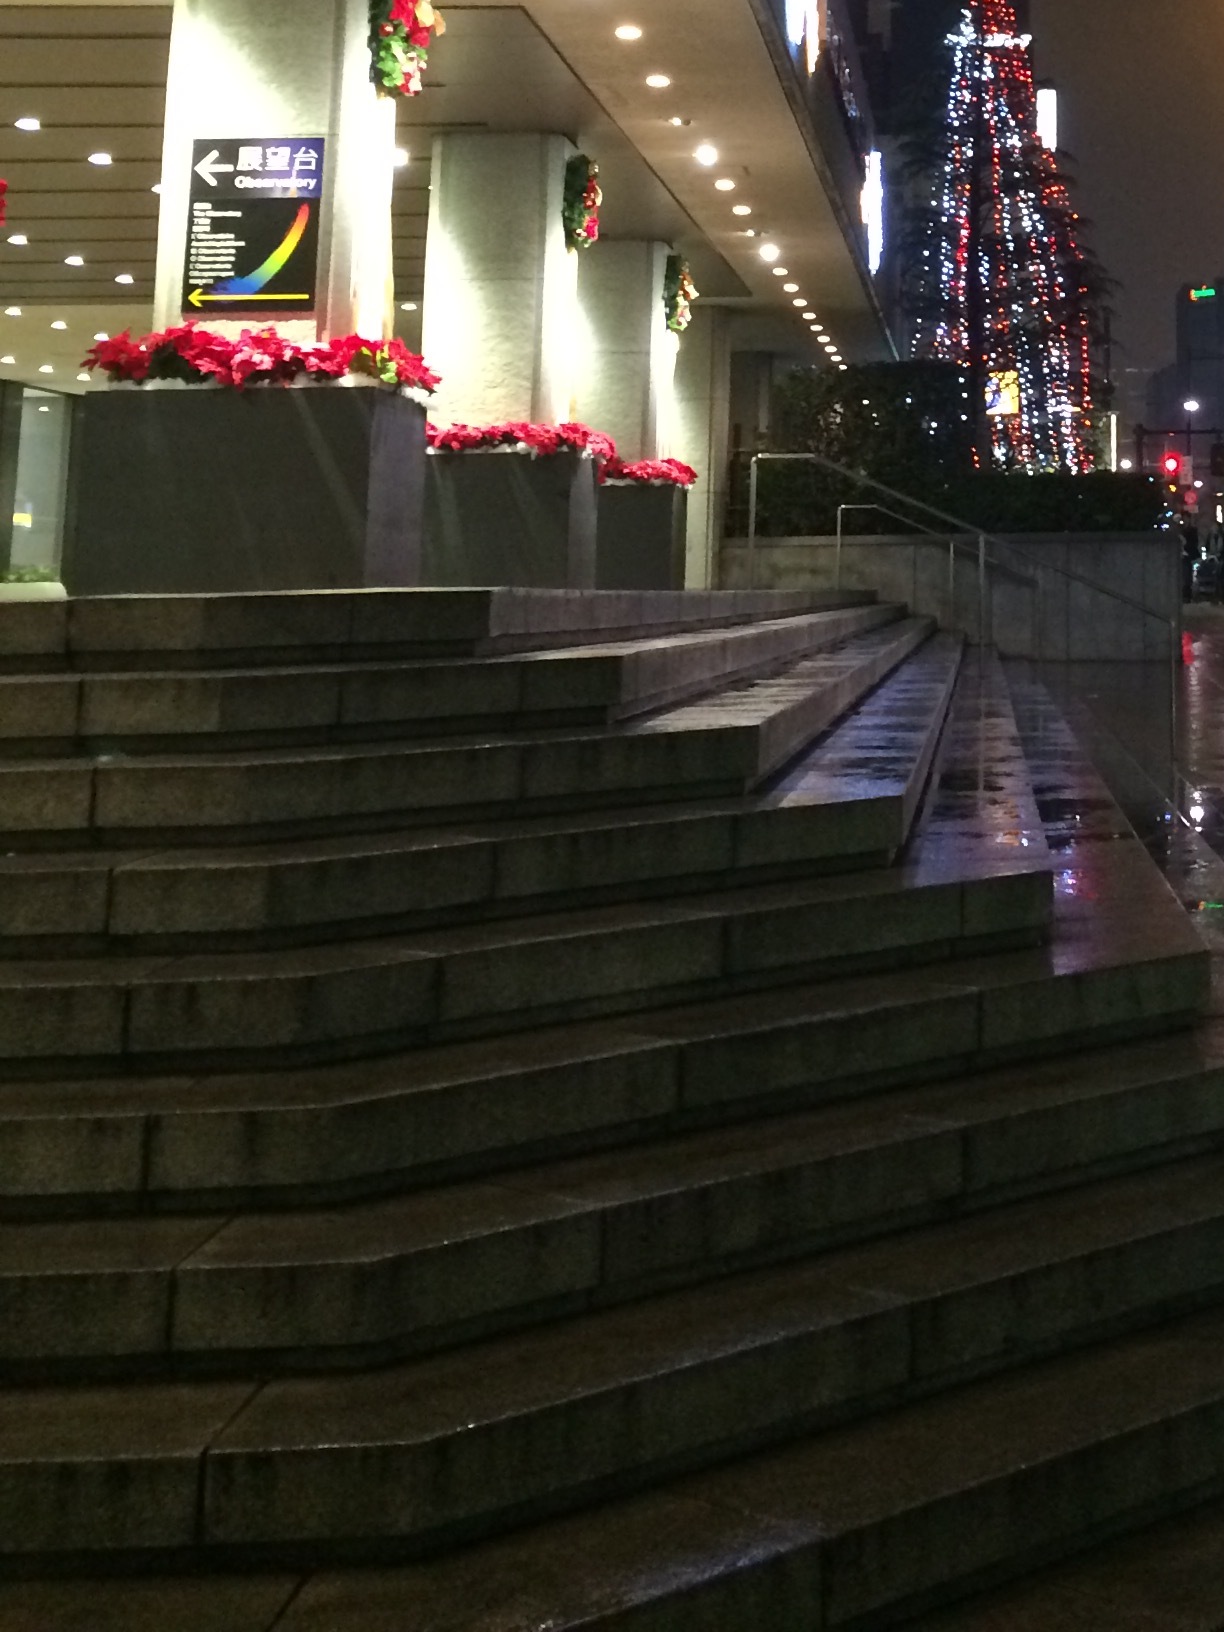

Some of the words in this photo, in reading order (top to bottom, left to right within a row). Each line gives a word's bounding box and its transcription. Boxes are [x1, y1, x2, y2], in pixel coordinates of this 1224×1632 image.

[236, 146, 318, 171] 展望台
[234, 175, 317, 189] Observatory
